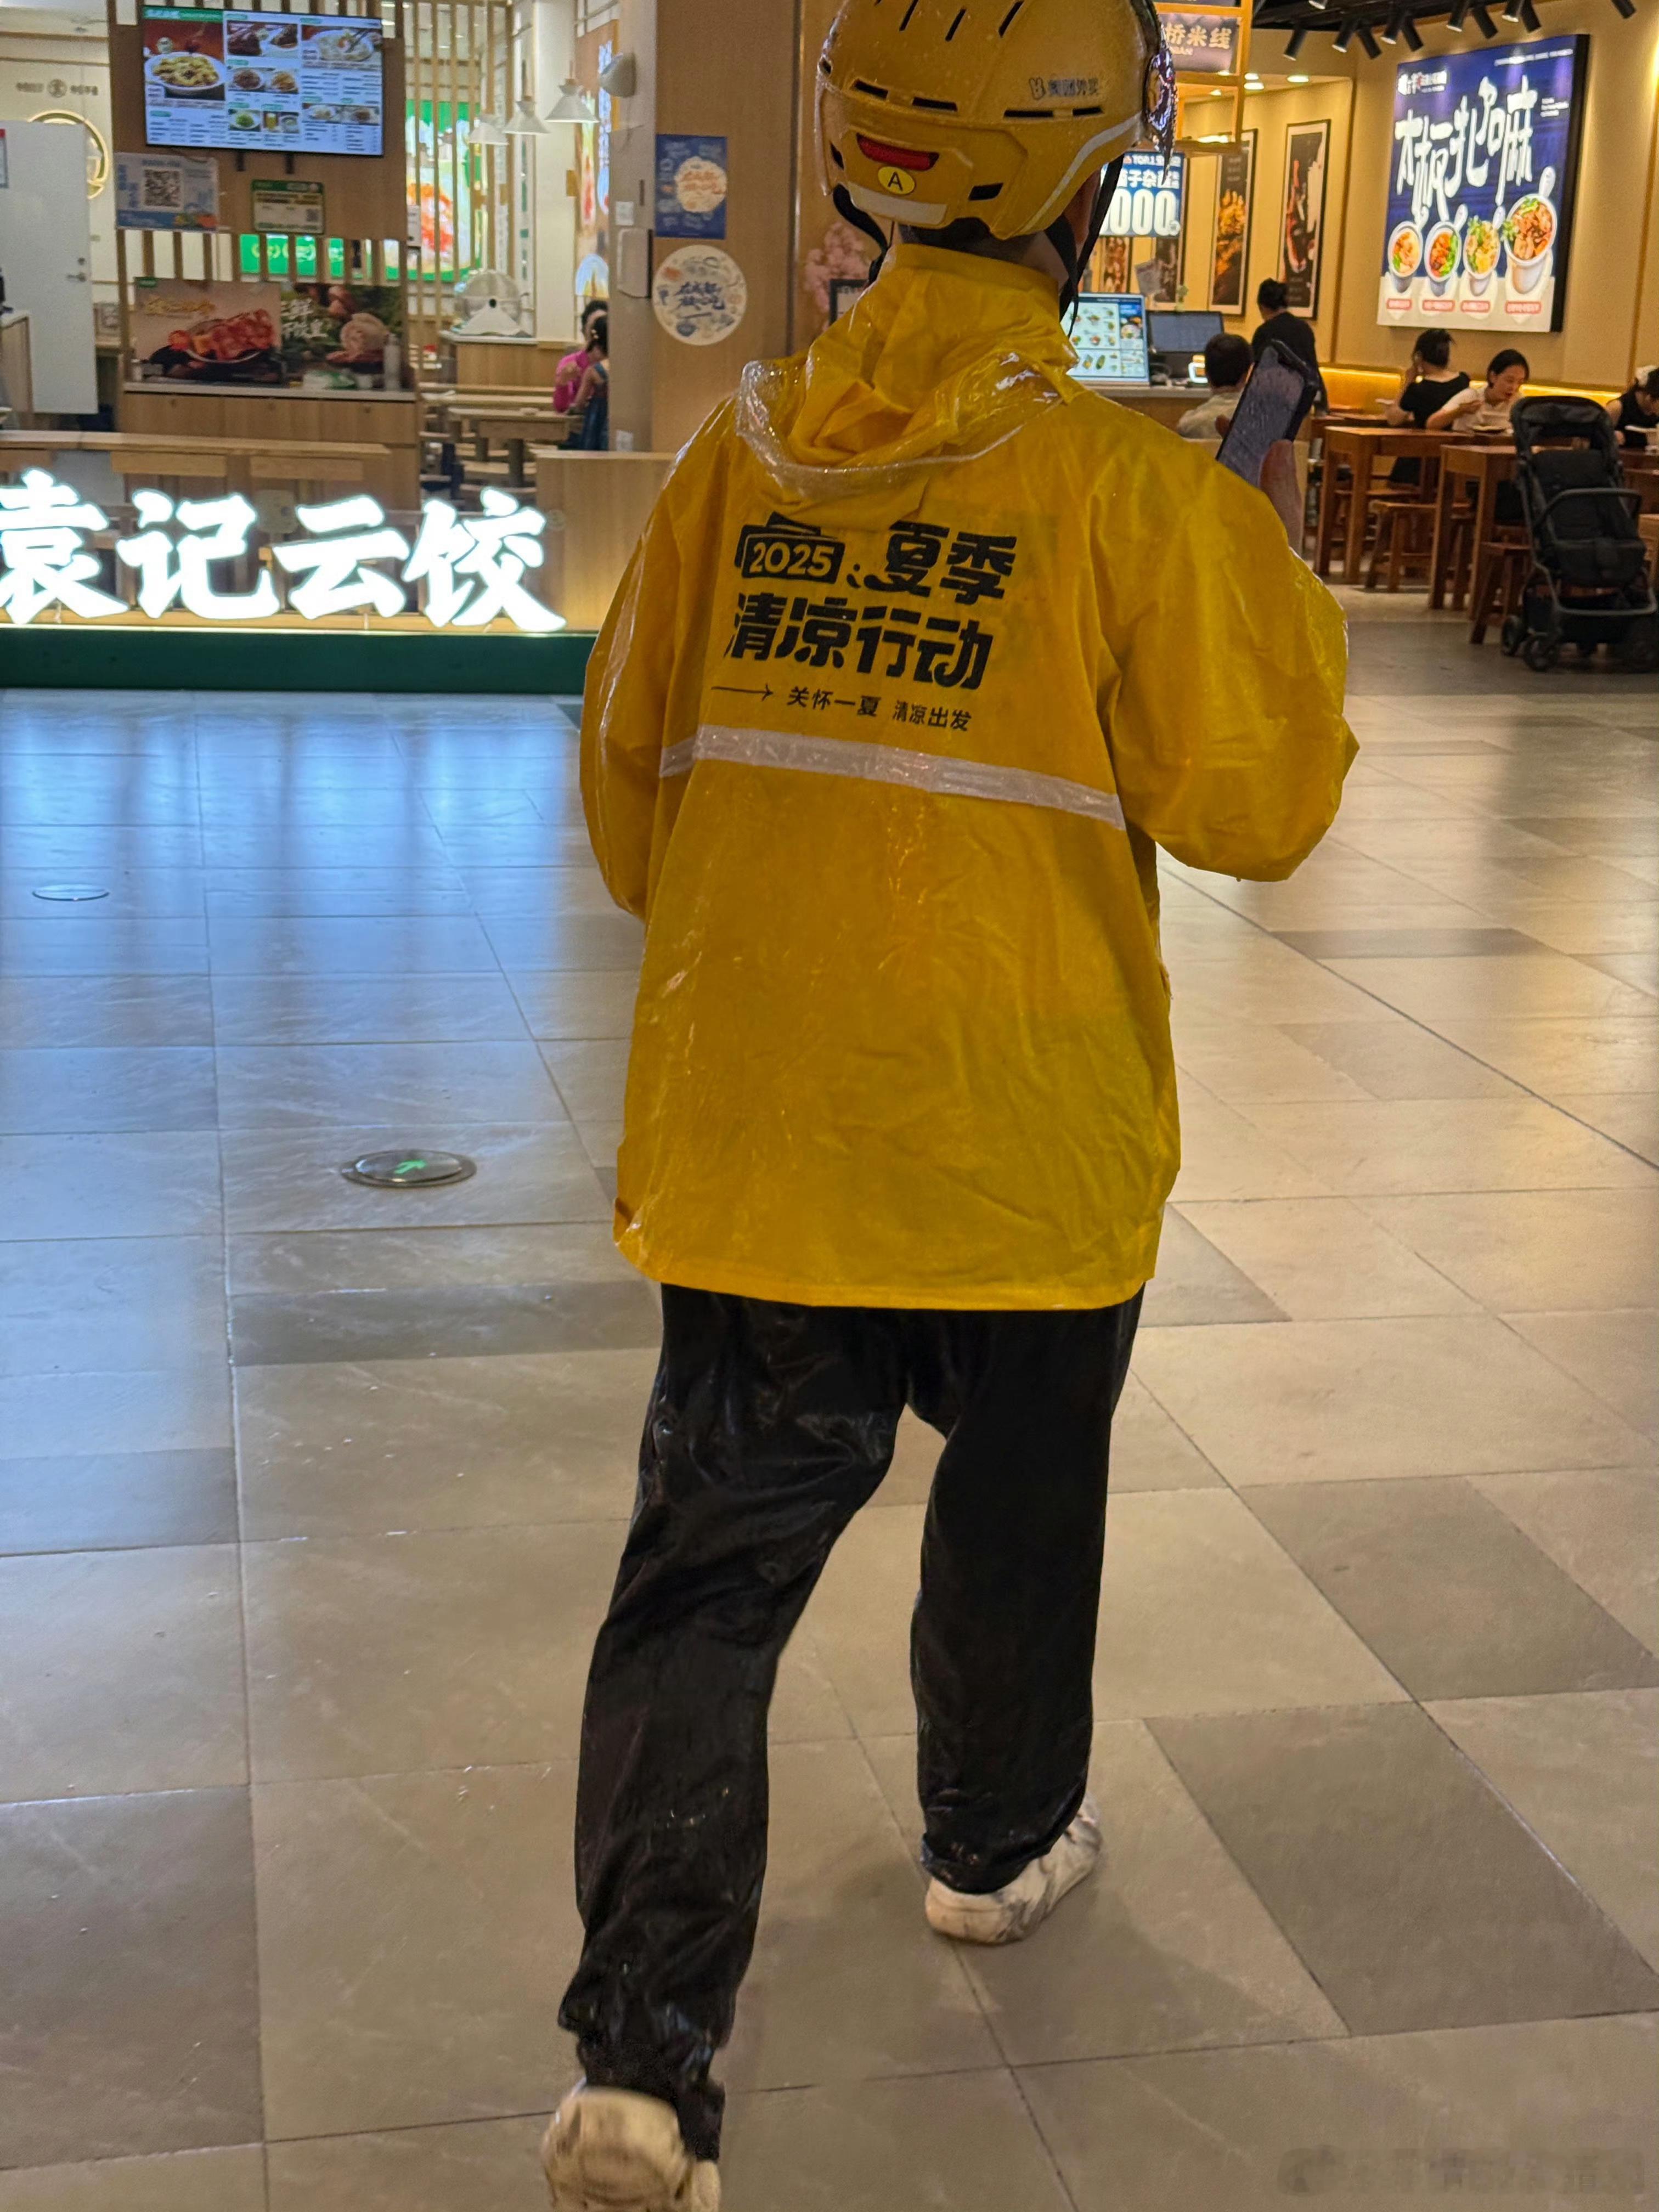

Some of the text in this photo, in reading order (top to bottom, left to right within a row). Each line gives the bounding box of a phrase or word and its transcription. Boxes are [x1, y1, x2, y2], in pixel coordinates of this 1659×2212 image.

[888, 171, 904, 192] A
[0, 467, 567, 631] 袁记云饺
[751, 520, 1018, 605] 2025 夏季
[723, 592, 994, 690] 清凉行动
[787, 687, 972, 732] 关怀一夏 清凉出发
